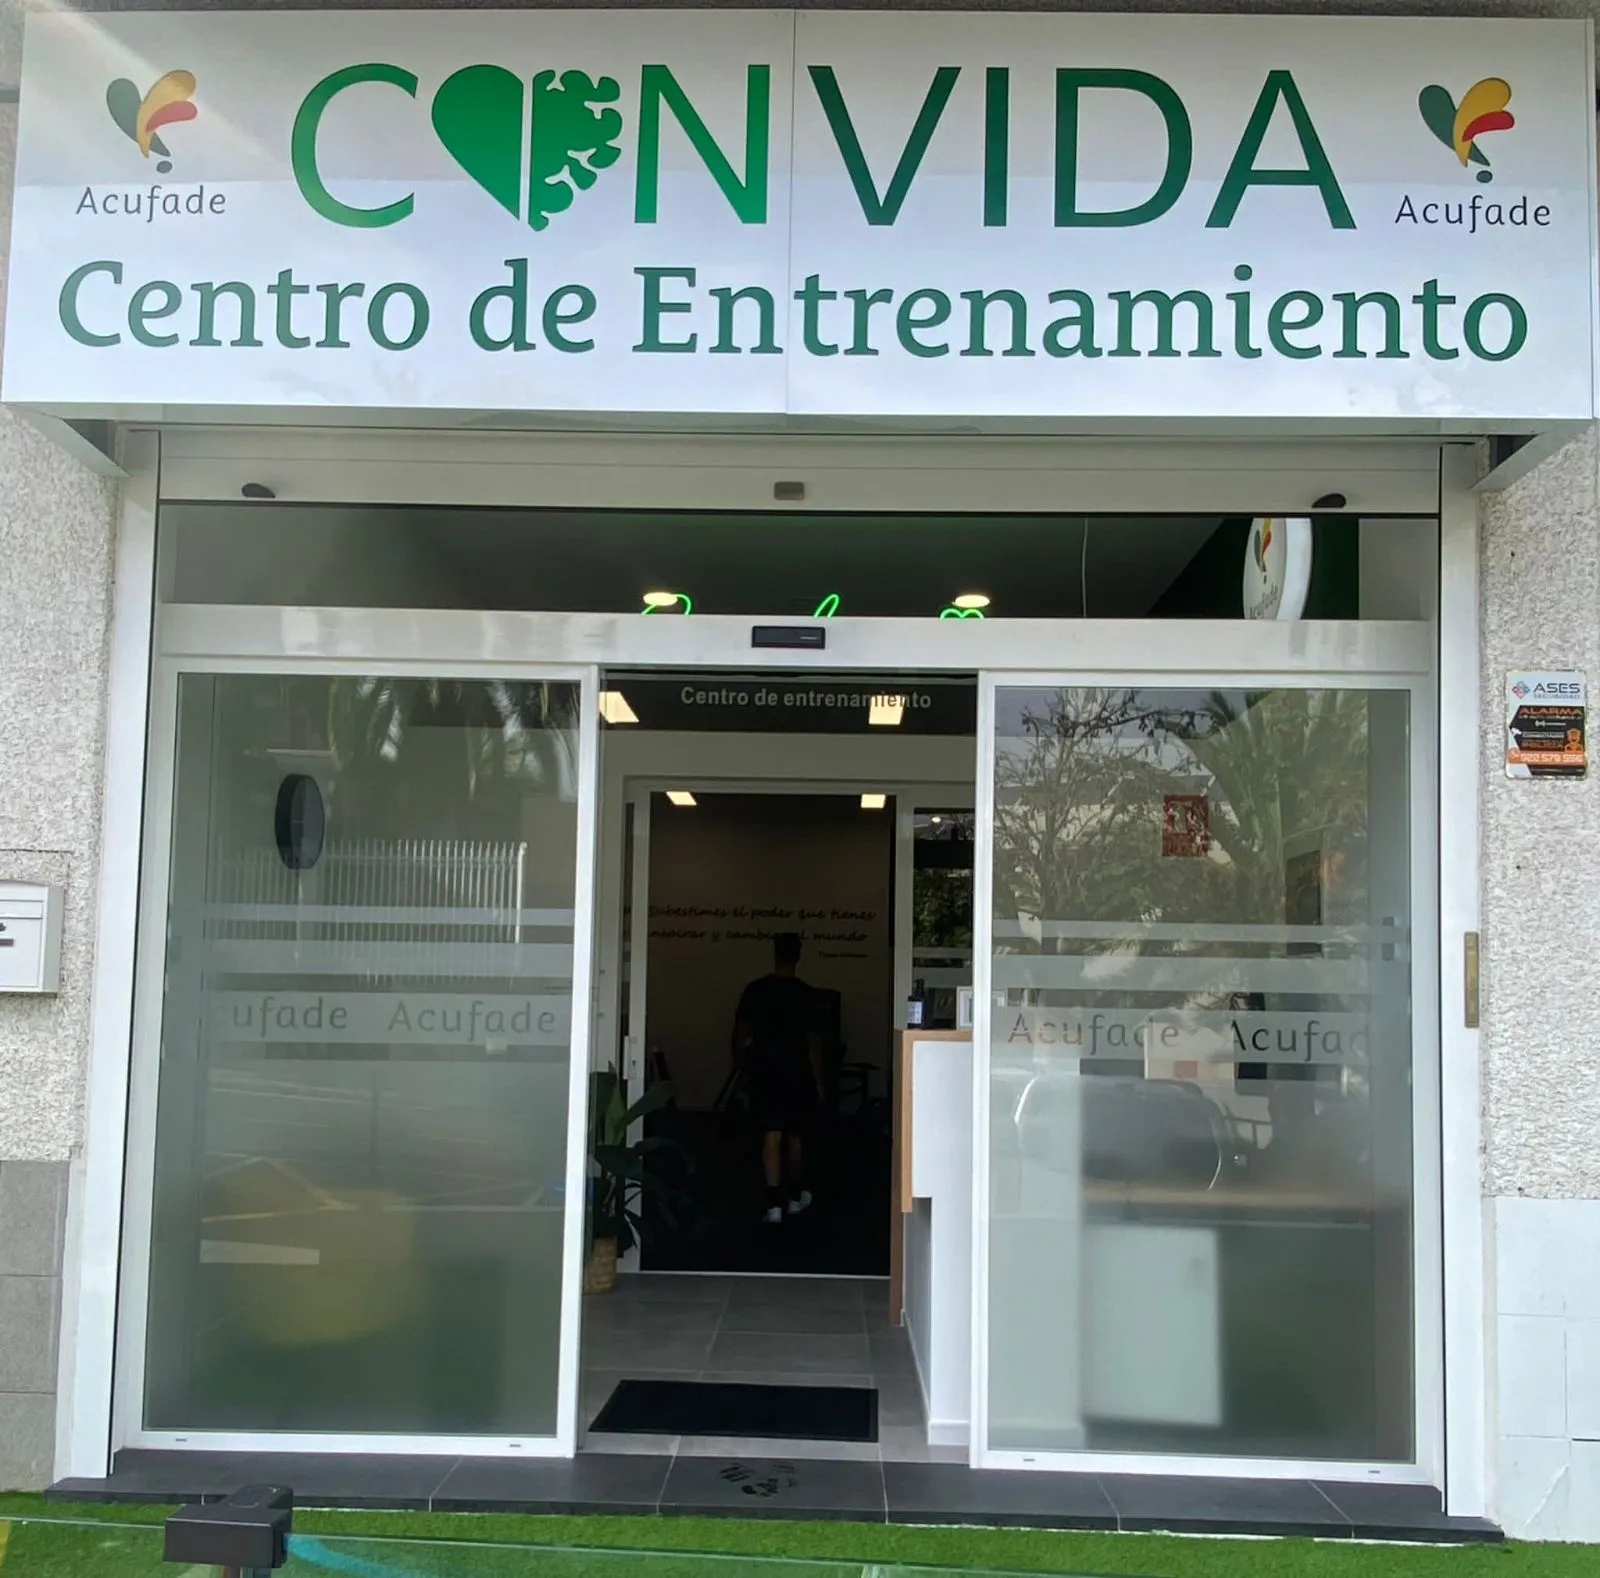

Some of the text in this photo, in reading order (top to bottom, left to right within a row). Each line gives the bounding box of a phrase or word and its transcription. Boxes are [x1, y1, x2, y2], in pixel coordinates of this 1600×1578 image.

[76, 184, 226, 223] Acufade
[1395, 194, 1551, 233] Acufade
[58, 257, 1528, 361] Centro de Entrenamiento
[680, 686, 932, 708] Centro de entrenamiento
[1533, 682, 1580, 694] ASES
[1520, 707, 1583, 715] ALARMA
[751, 904, 794, 920] poder
[812, 929, 870, 942] mundo
[387, 1000, 555, 1042] Acufade
[1007, 1013, 1179, 1055] Acufade
